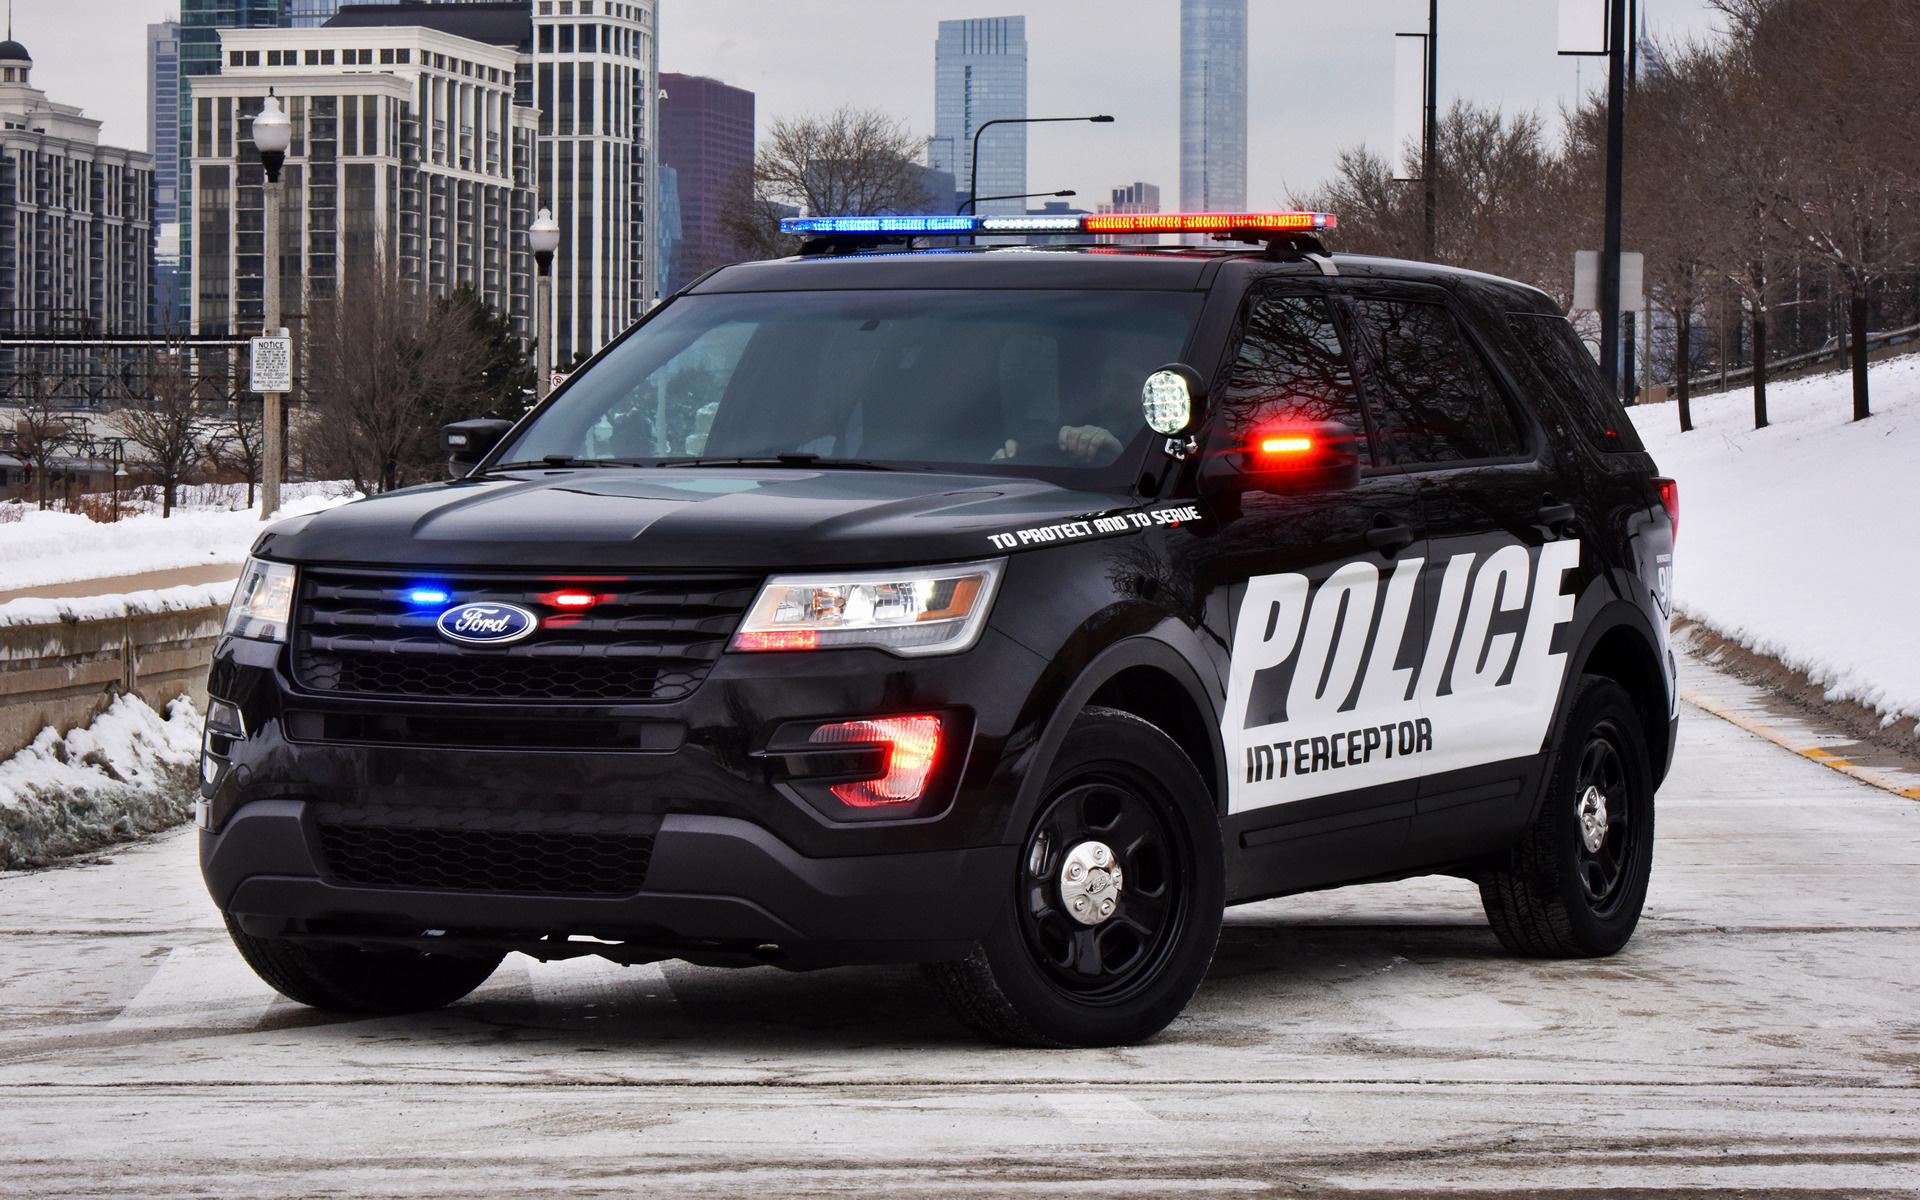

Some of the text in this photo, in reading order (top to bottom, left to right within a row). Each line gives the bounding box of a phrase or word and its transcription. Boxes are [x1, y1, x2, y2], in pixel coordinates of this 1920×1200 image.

[258, 341, 285, 349] NOTICE
[987, 505, 1202, 550] TO PROTECT AND TO SERVE
[455, 607, 511, 633] Ford
[1225, 539, 1580, 730] POLICE
[1246, 717, 1433, 784] INTERCEPTOR
